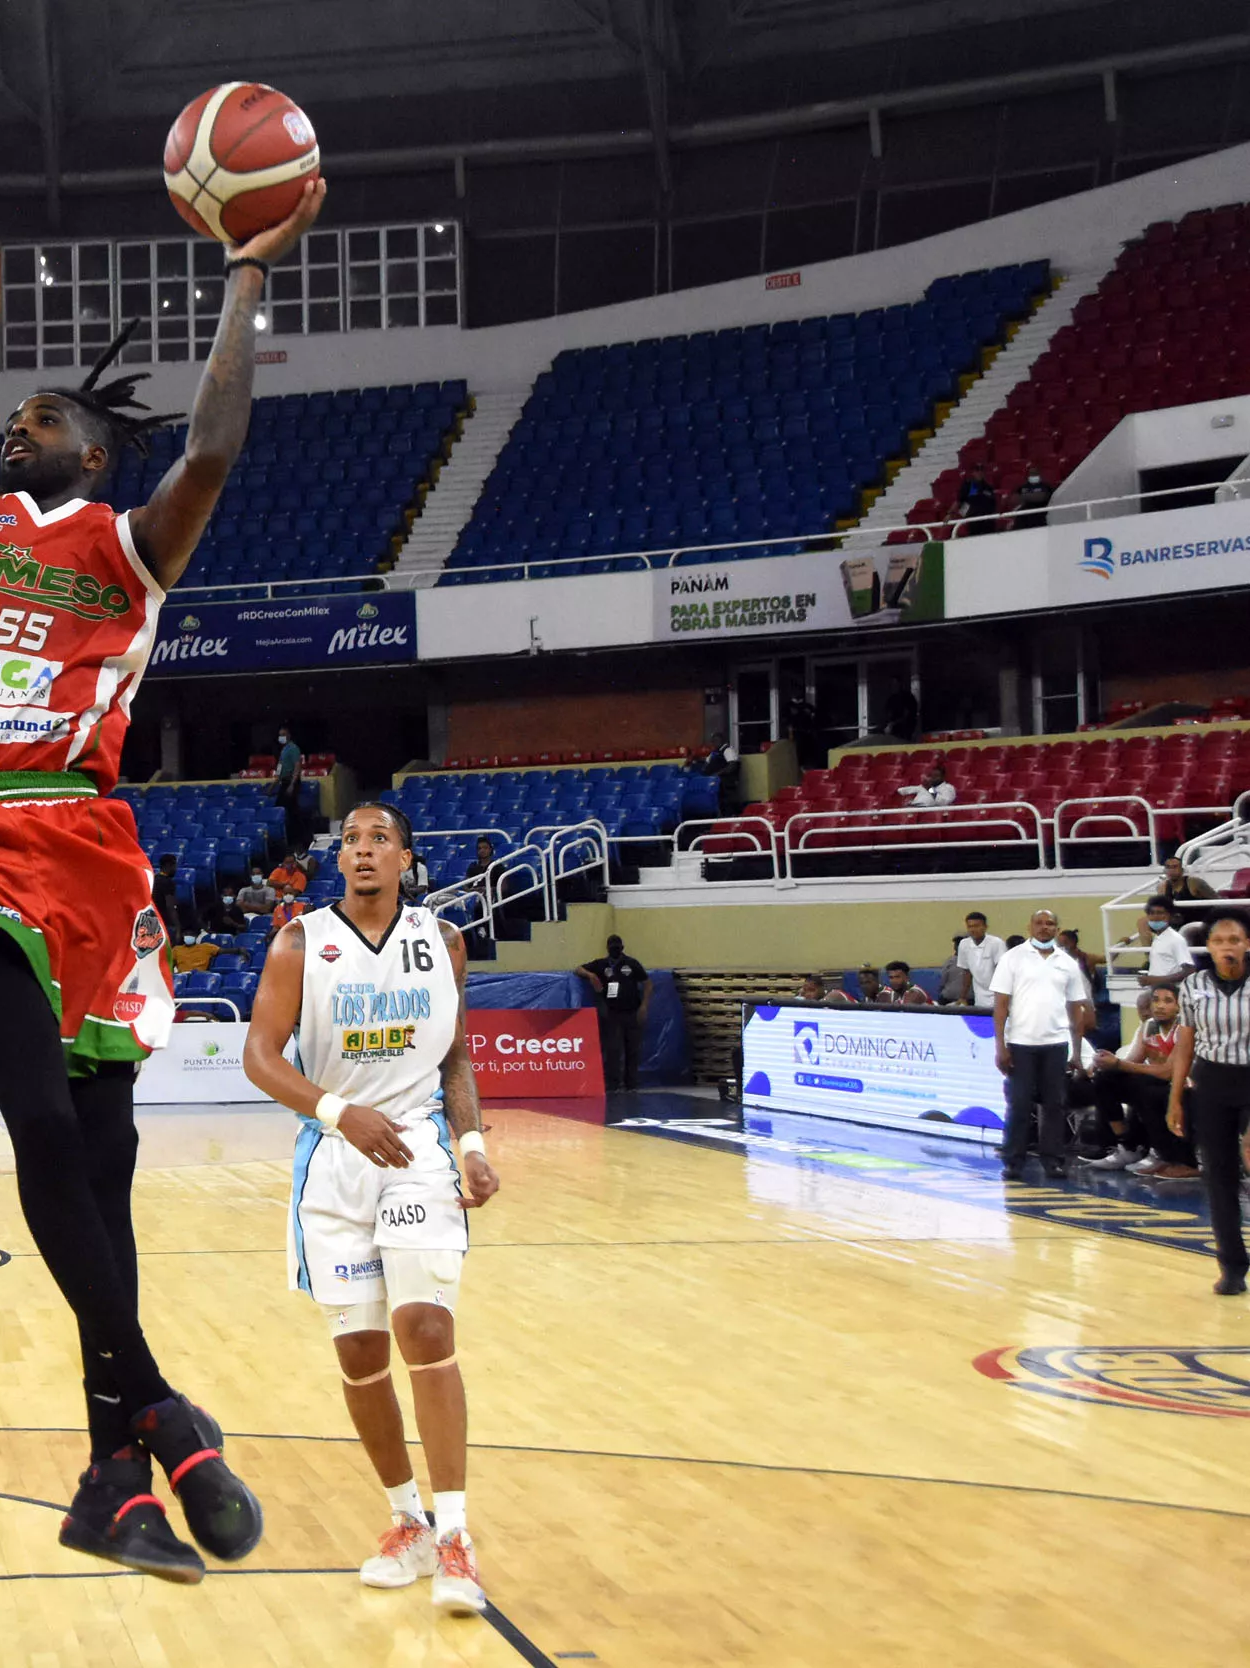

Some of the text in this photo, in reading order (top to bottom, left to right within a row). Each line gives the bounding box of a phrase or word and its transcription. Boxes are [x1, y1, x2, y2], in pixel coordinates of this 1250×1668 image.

[670, 577, 730, 595] PANAM
[237, 607, 330, 621] #RDCreceConMilex
[670, 593, 817, 618] PARA EXPERTOS EN
[671, 609, 808, 632] OBRAS MAESTRAS
[150, 635, 229, 665] Milex
[327, 624, 408, 655] Milex
[400, 939, 434, 973] 16
[337, 983, 375, 994] CLUB
[332, 987, 431, 1026] LOS PRADOS
[495, 1034, 583, 1055] Crecer
[824, 1033, 937, 1062] DOMINICANA
[183, 1058, 214, 1066] PUNTA
[470, 1062, 485, 1073] or
[503, 1062, 525, 1075] por
[529, 1060, 543, 1071] tu
[547, 1058, 586, 1071] futuro
[382, 1204, 426, 1227] CAASD
